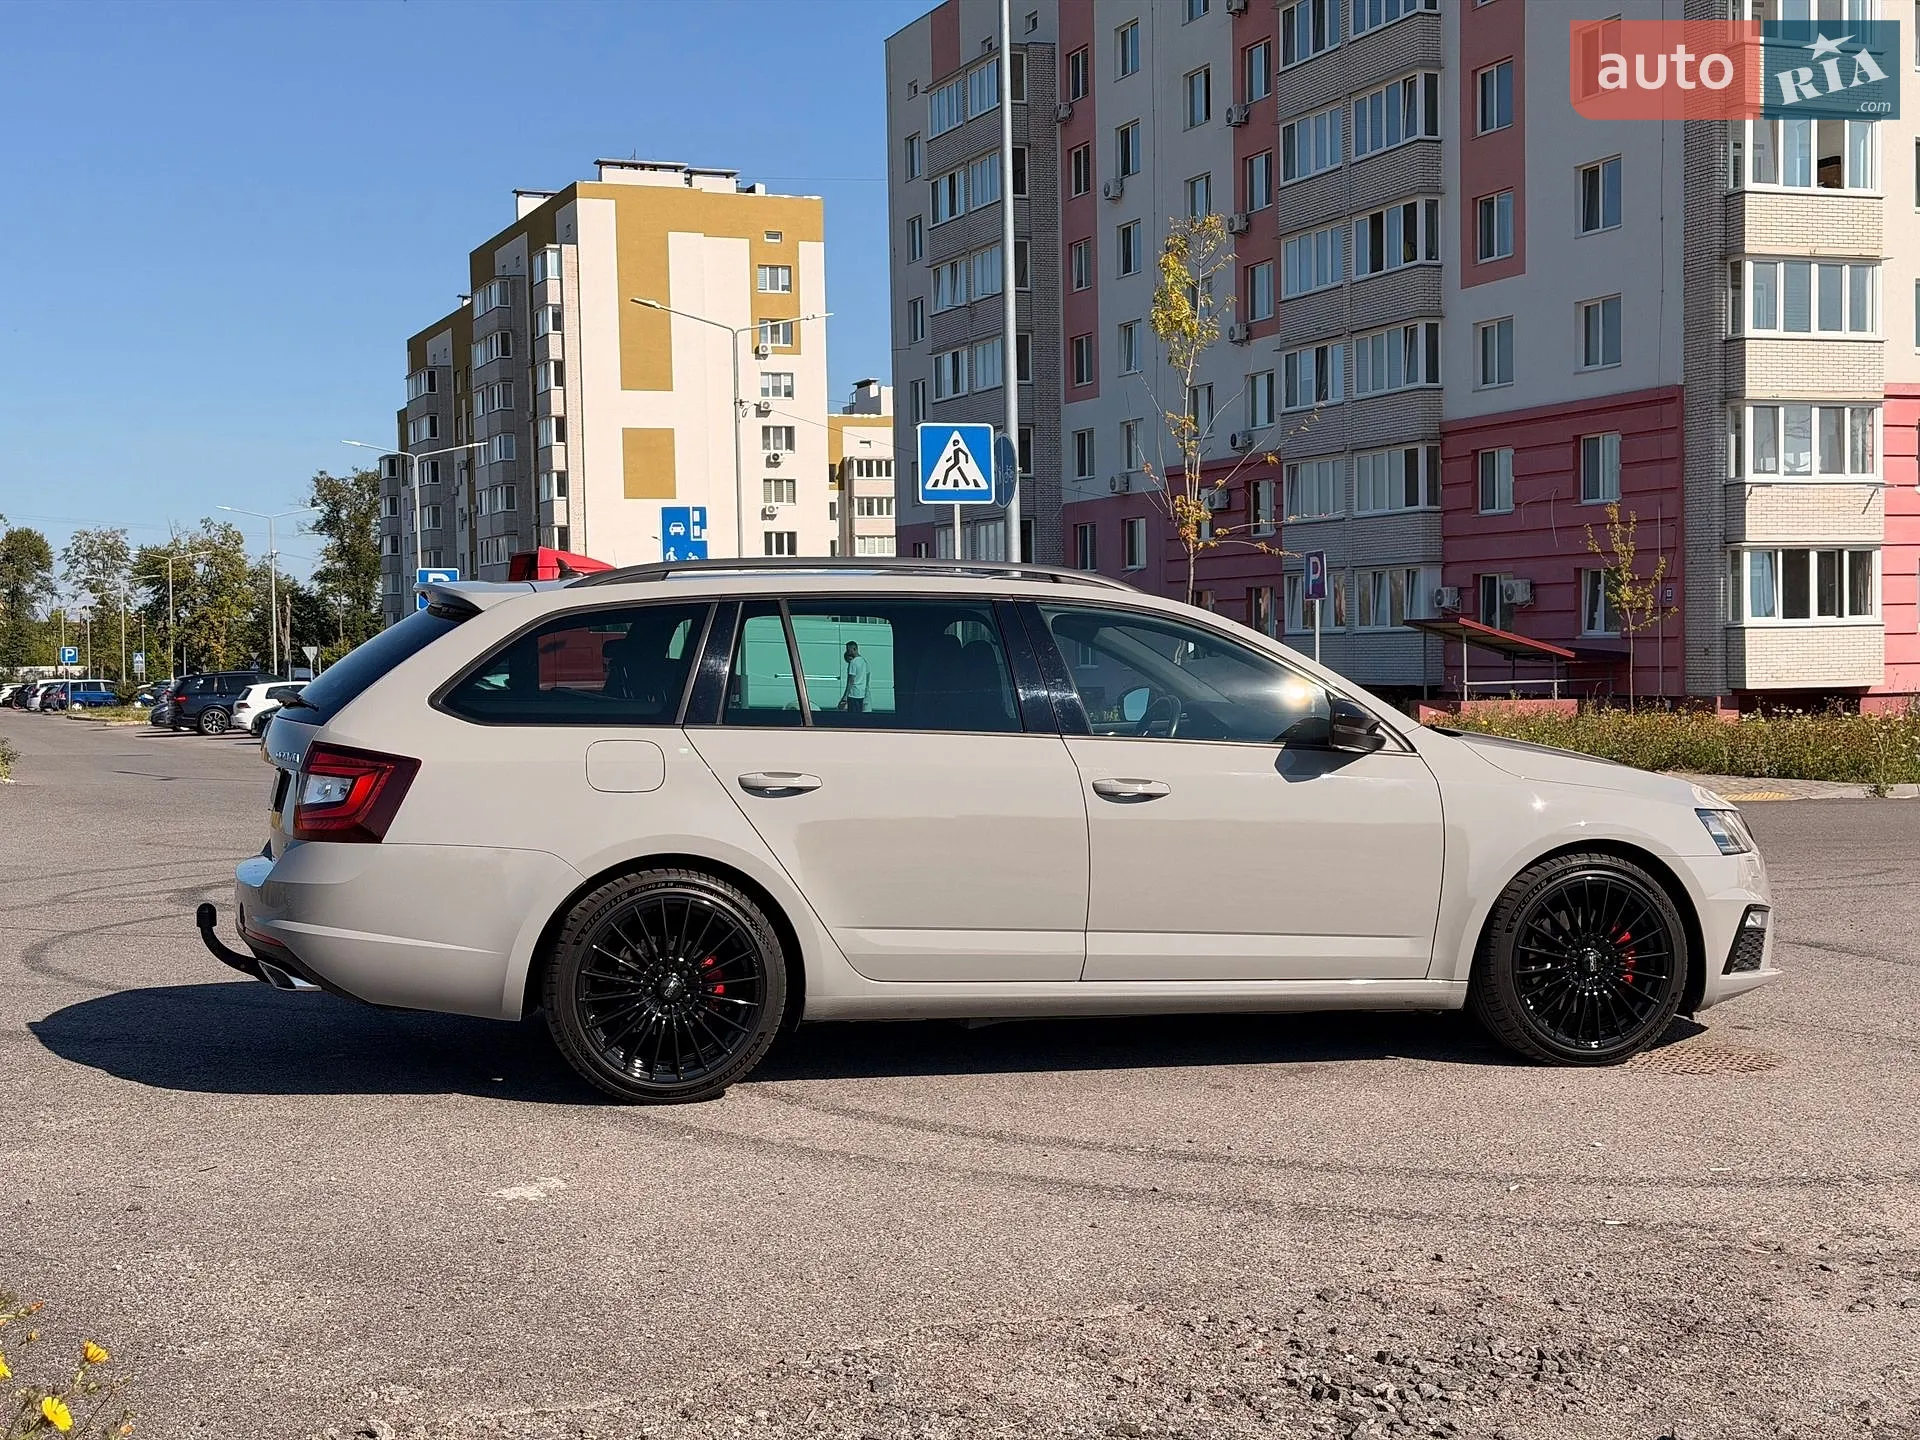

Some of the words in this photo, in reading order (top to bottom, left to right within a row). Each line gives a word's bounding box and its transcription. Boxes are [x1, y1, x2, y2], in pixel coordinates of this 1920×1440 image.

[1309, 556, 1321, 595] P
[65, 648, 75, 661] P
[584, 891, 629, 933] MICHELIN
